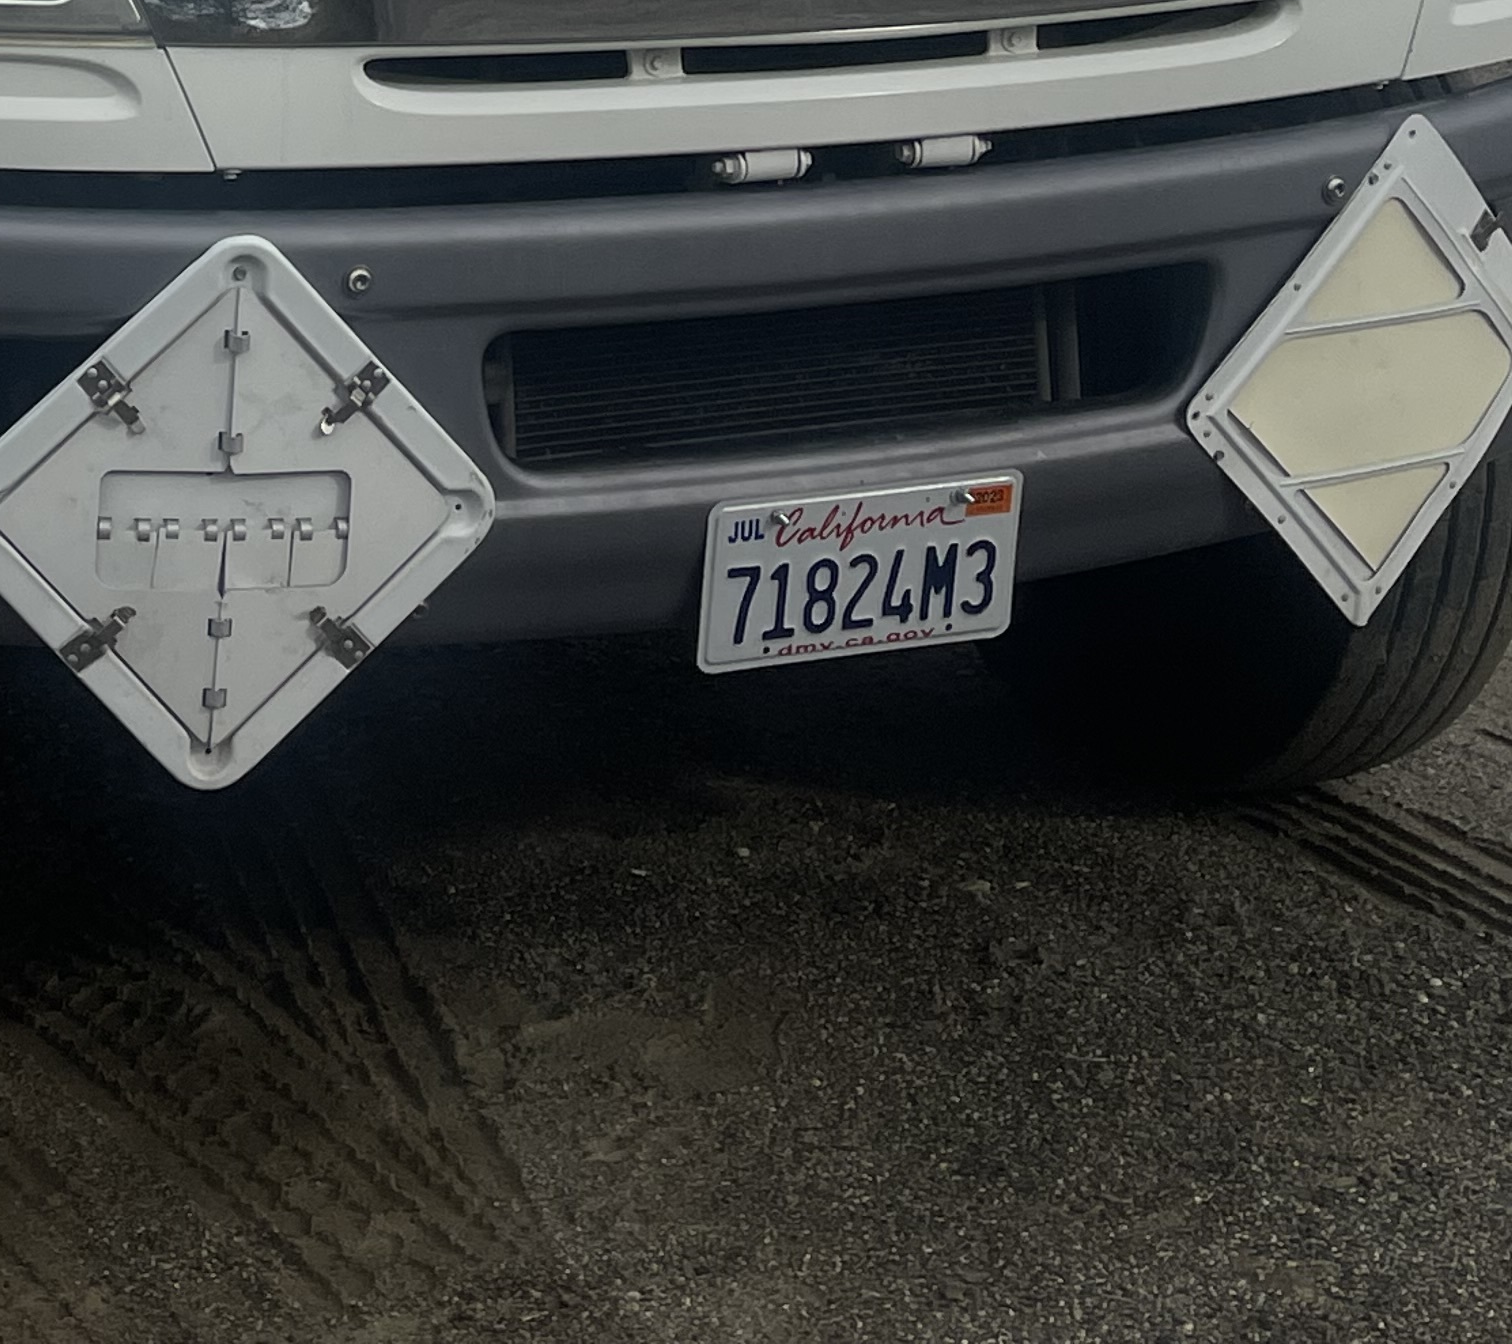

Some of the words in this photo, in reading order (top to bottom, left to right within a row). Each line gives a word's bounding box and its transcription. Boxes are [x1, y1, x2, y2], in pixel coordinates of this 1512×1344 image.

[728, 518, 765, 544] JUL
[775, 501, 965, 551] California
[727, 540, 997, 646] 71824M3
[778, 627, 935, 657] dmv.ca.gov
